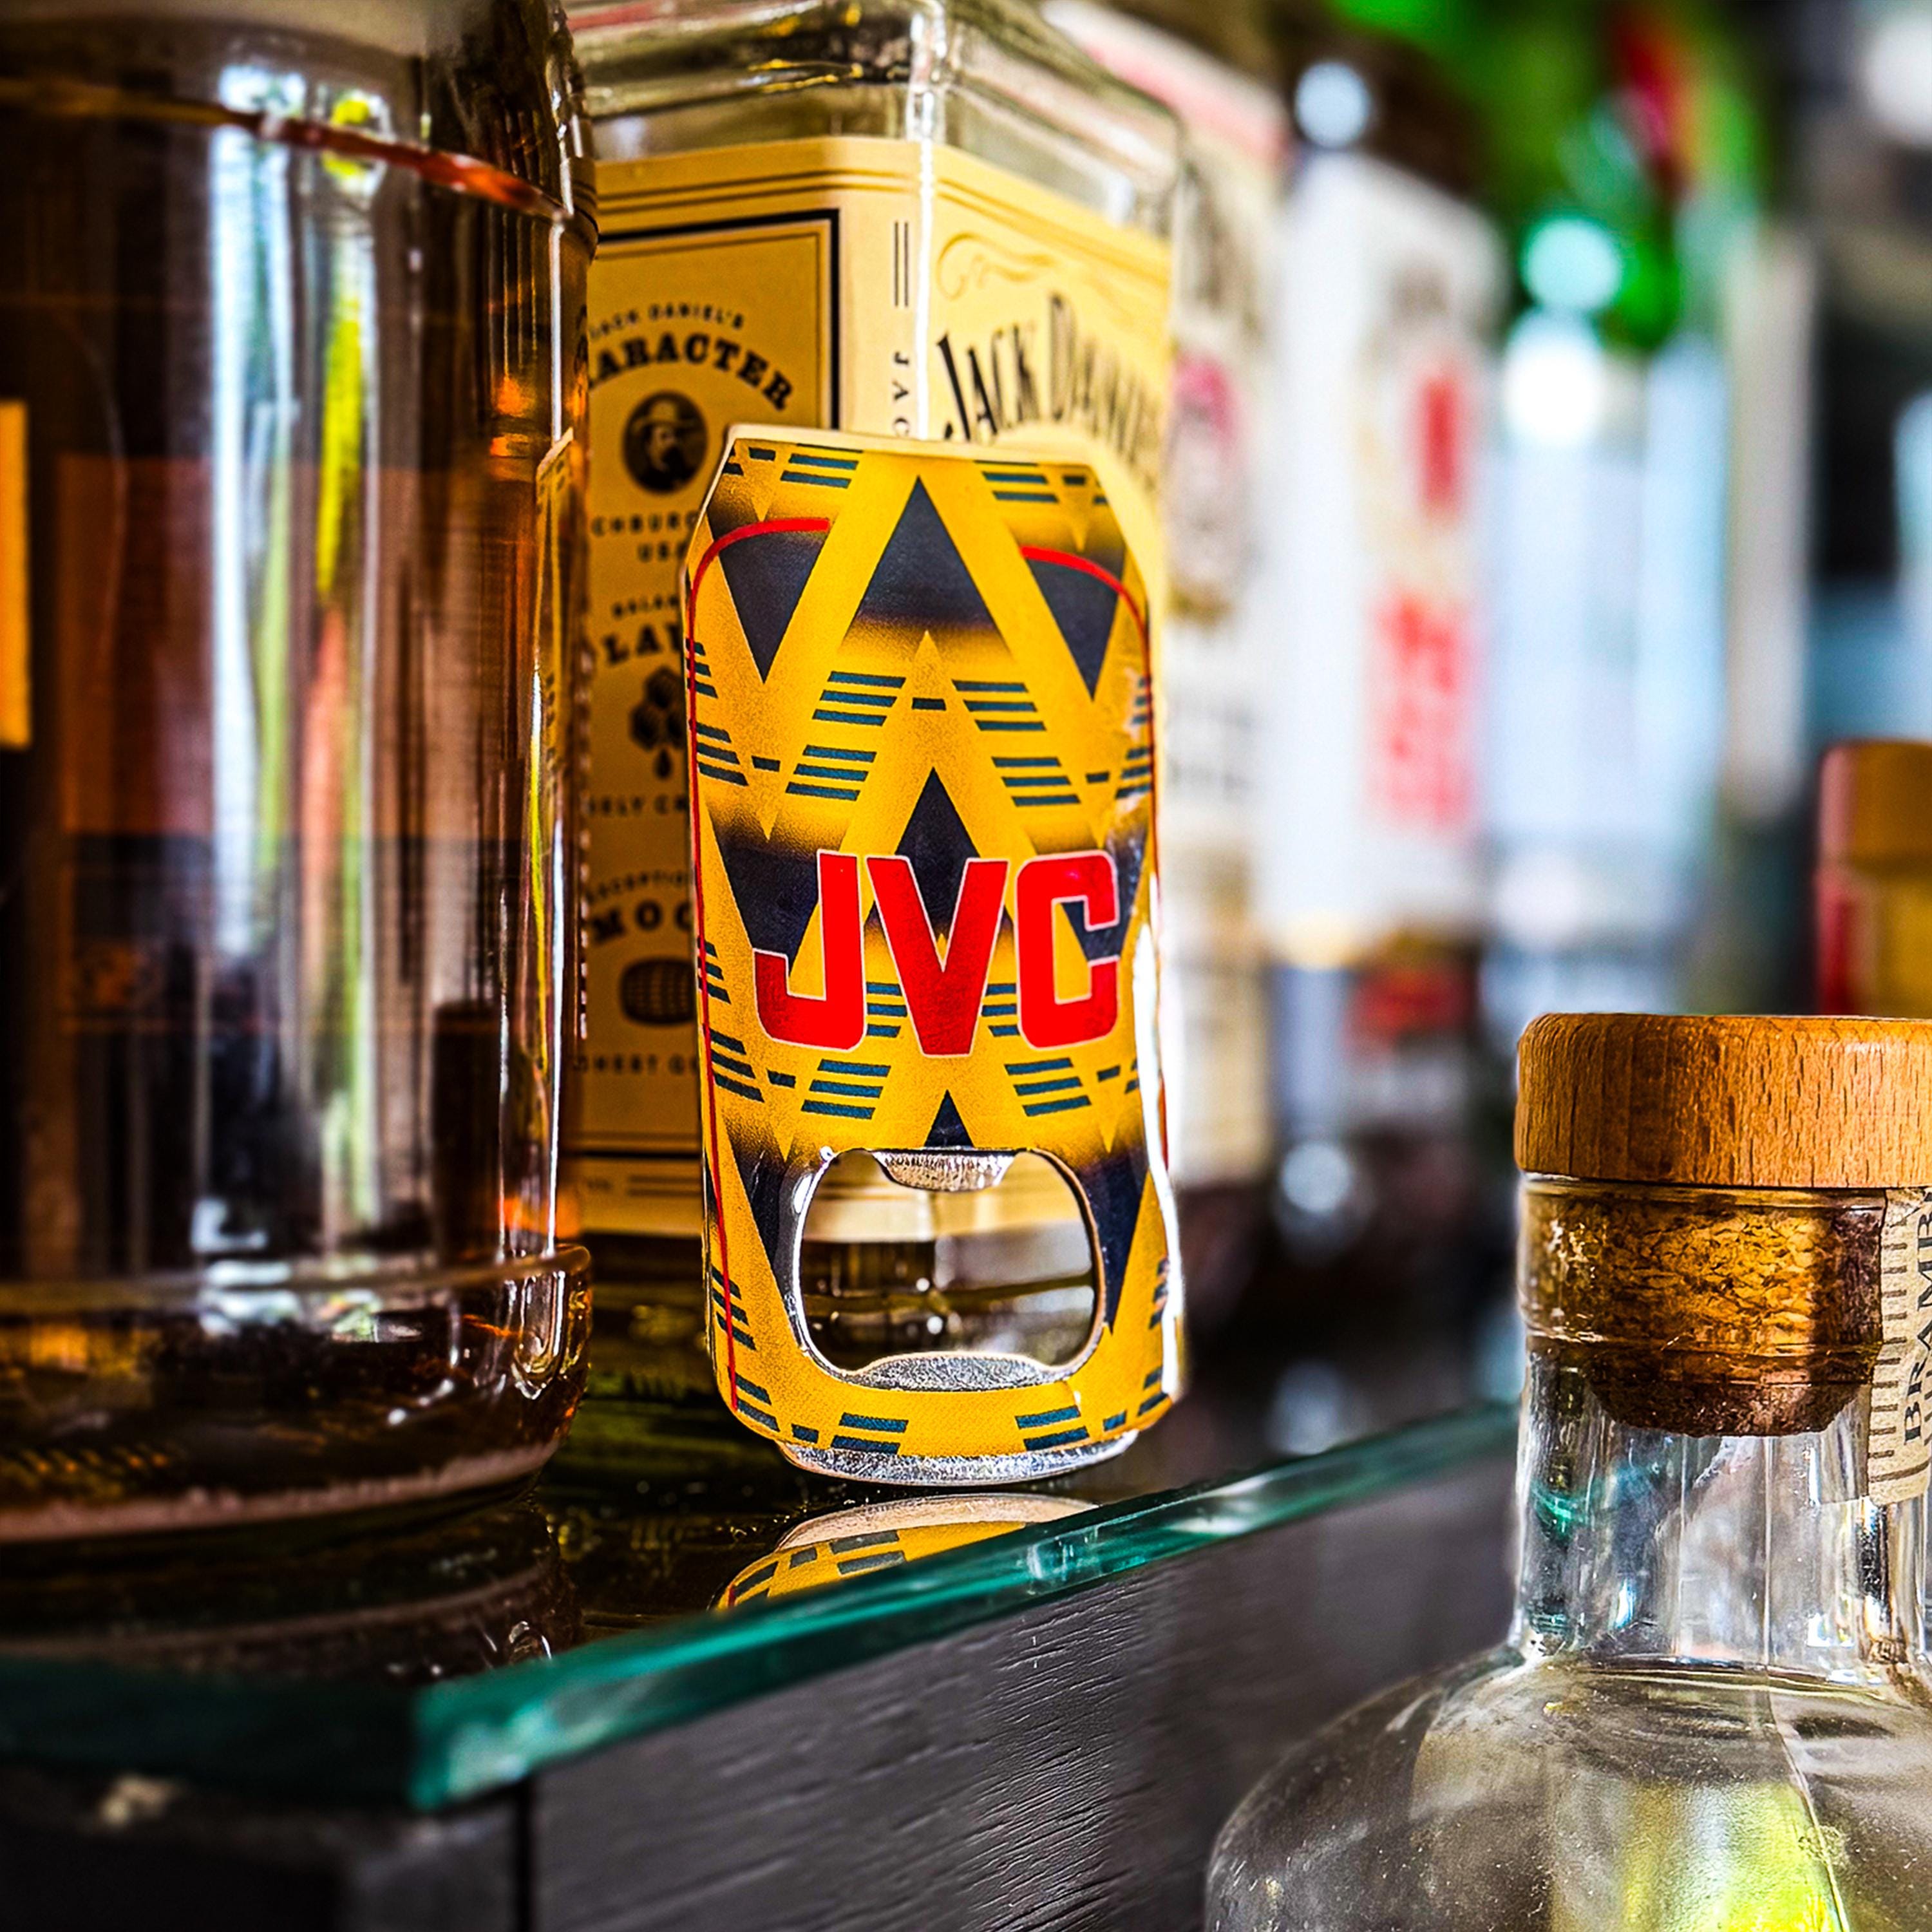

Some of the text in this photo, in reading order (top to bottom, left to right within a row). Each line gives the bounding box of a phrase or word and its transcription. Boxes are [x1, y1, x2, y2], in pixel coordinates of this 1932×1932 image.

[587, 332, 794, 412] ARACTER
[893, 351, 911, 438] JAC
[752, 848, 1120, 1057] JVC
[1904, 1190, 1932, 1447] BRAMB
